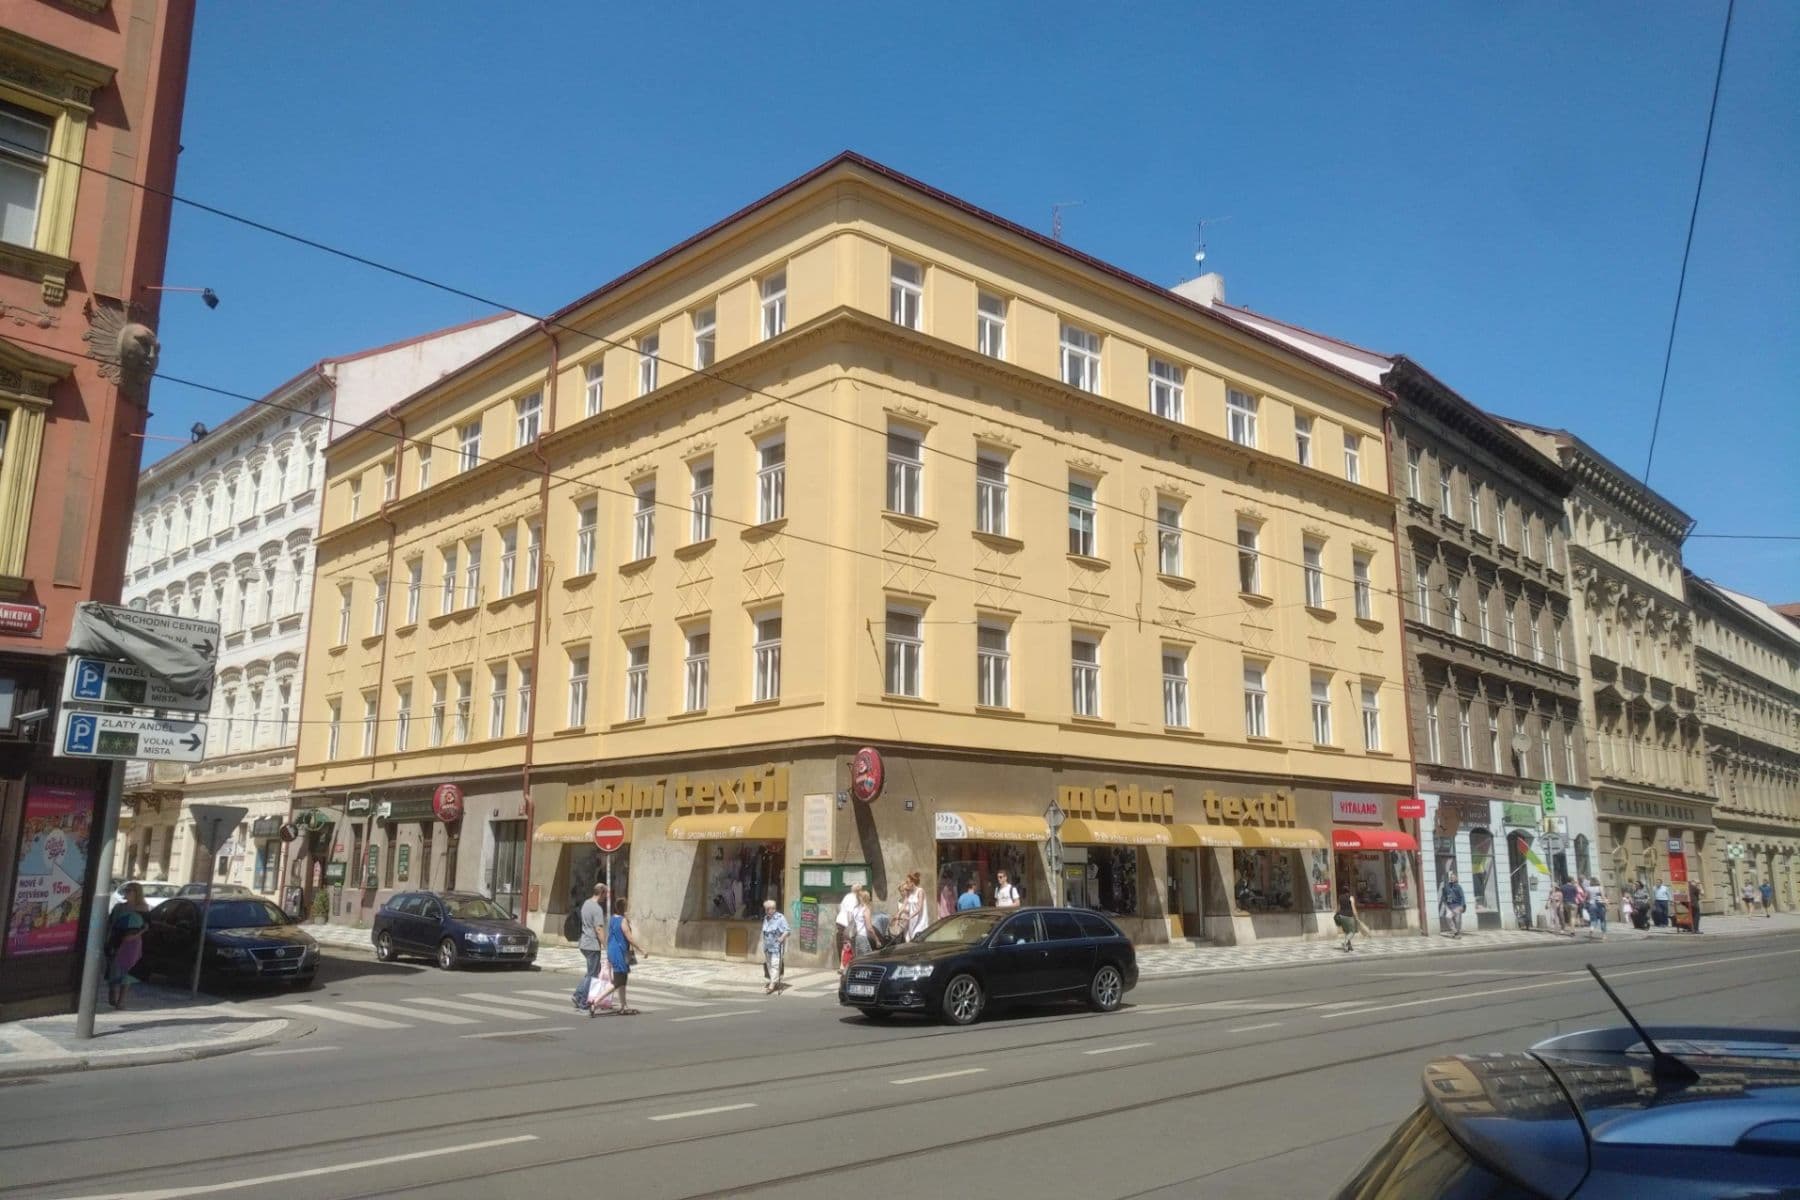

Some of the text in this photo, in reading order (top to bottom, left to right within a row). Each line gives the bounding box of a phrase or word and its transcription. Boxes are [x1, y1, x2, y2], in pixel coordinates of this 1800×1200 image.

[172, 621, 218, 634] CENTRUM
[101, 718, 136, 730] ZLATÝ
[143, 736, 175, 746] VOLNÁ
[143, 745, 171, 755] MÍSTA
[675, 762, 789, 809] textil
[1202, 788, 1296, 822] textil
[1340, 801, 1377, 815] VITALAND
[1617, 799, 1659, 816] CASINO
